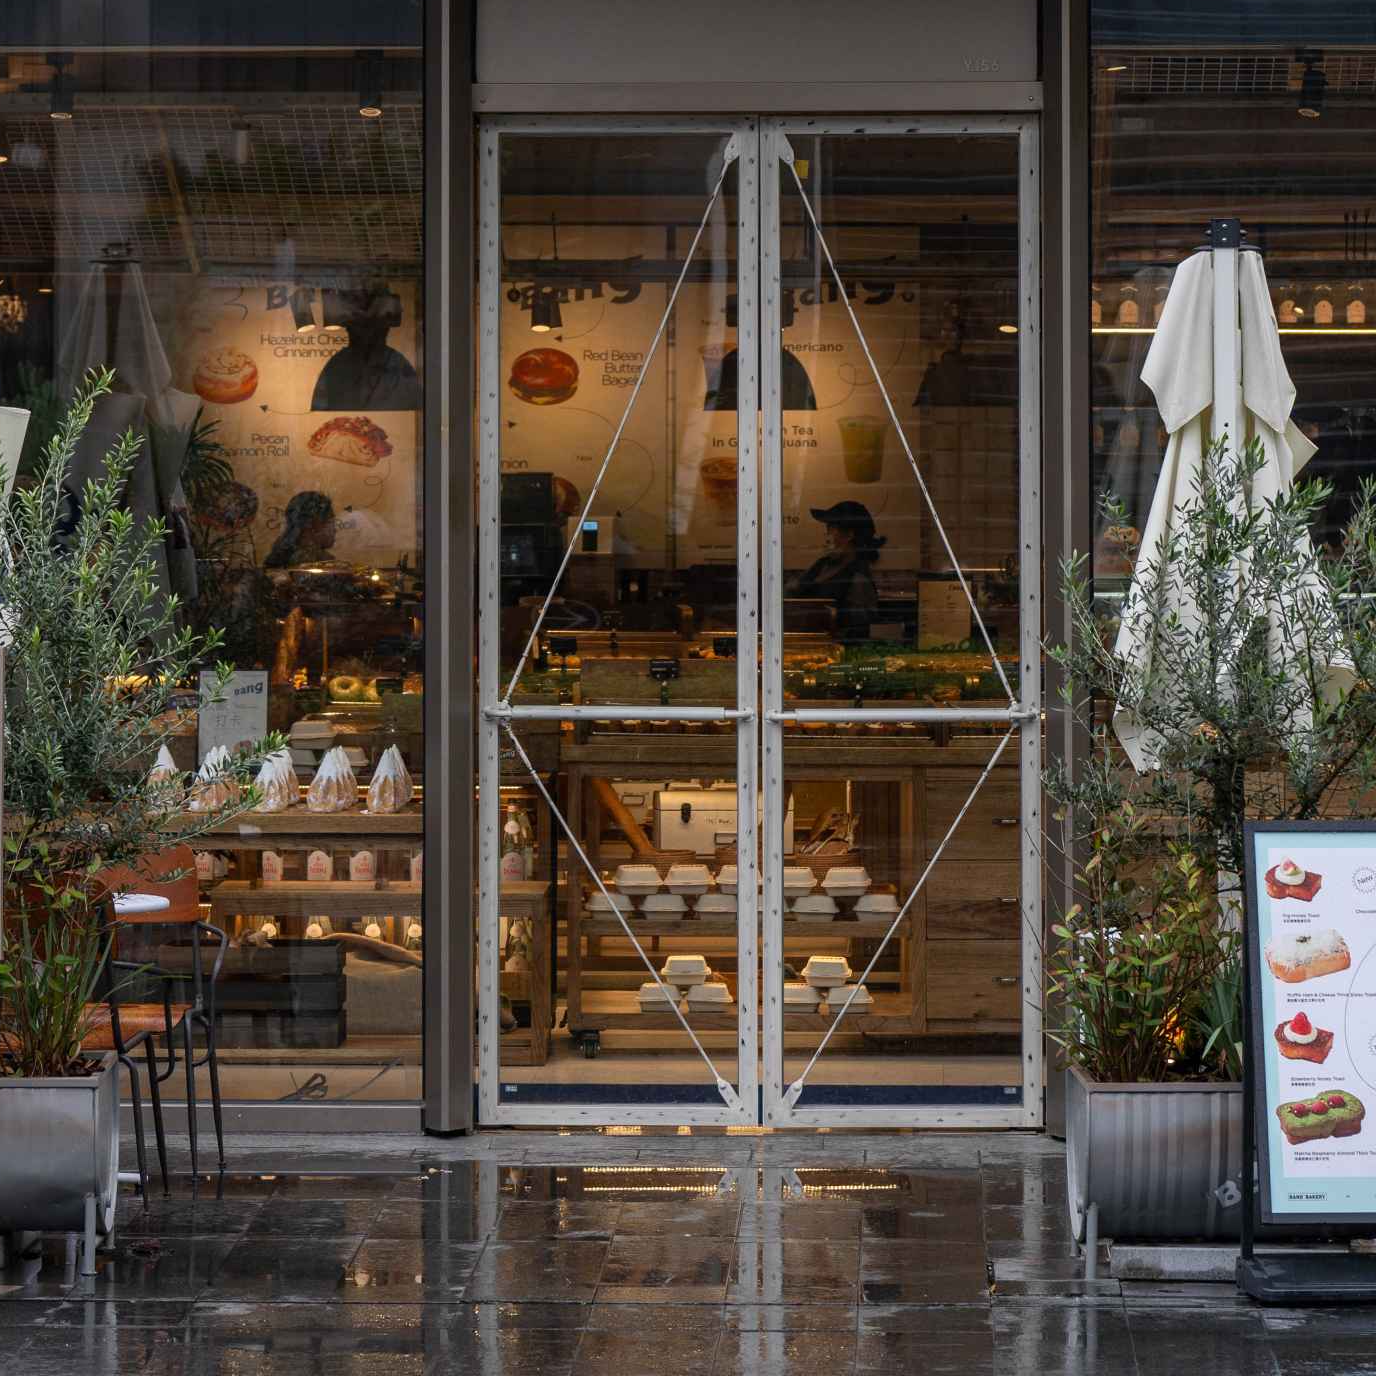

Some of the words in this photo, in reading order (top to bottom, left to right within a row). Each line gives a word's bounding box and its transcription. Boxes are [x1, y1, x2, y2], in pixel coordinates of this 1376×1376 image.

[260, 334, 316, 346] Hazelnut
[783, 342, 844, 353] mericano
[583, 350, 608, 361] Red
[611, 350, 644, 361] Bean
[791, 426, 814, 436] Tea
[251, 434, 290, 445] Pecan
[266, 445, 290, 457] Roll
[501, 459, 529, 469] nion
